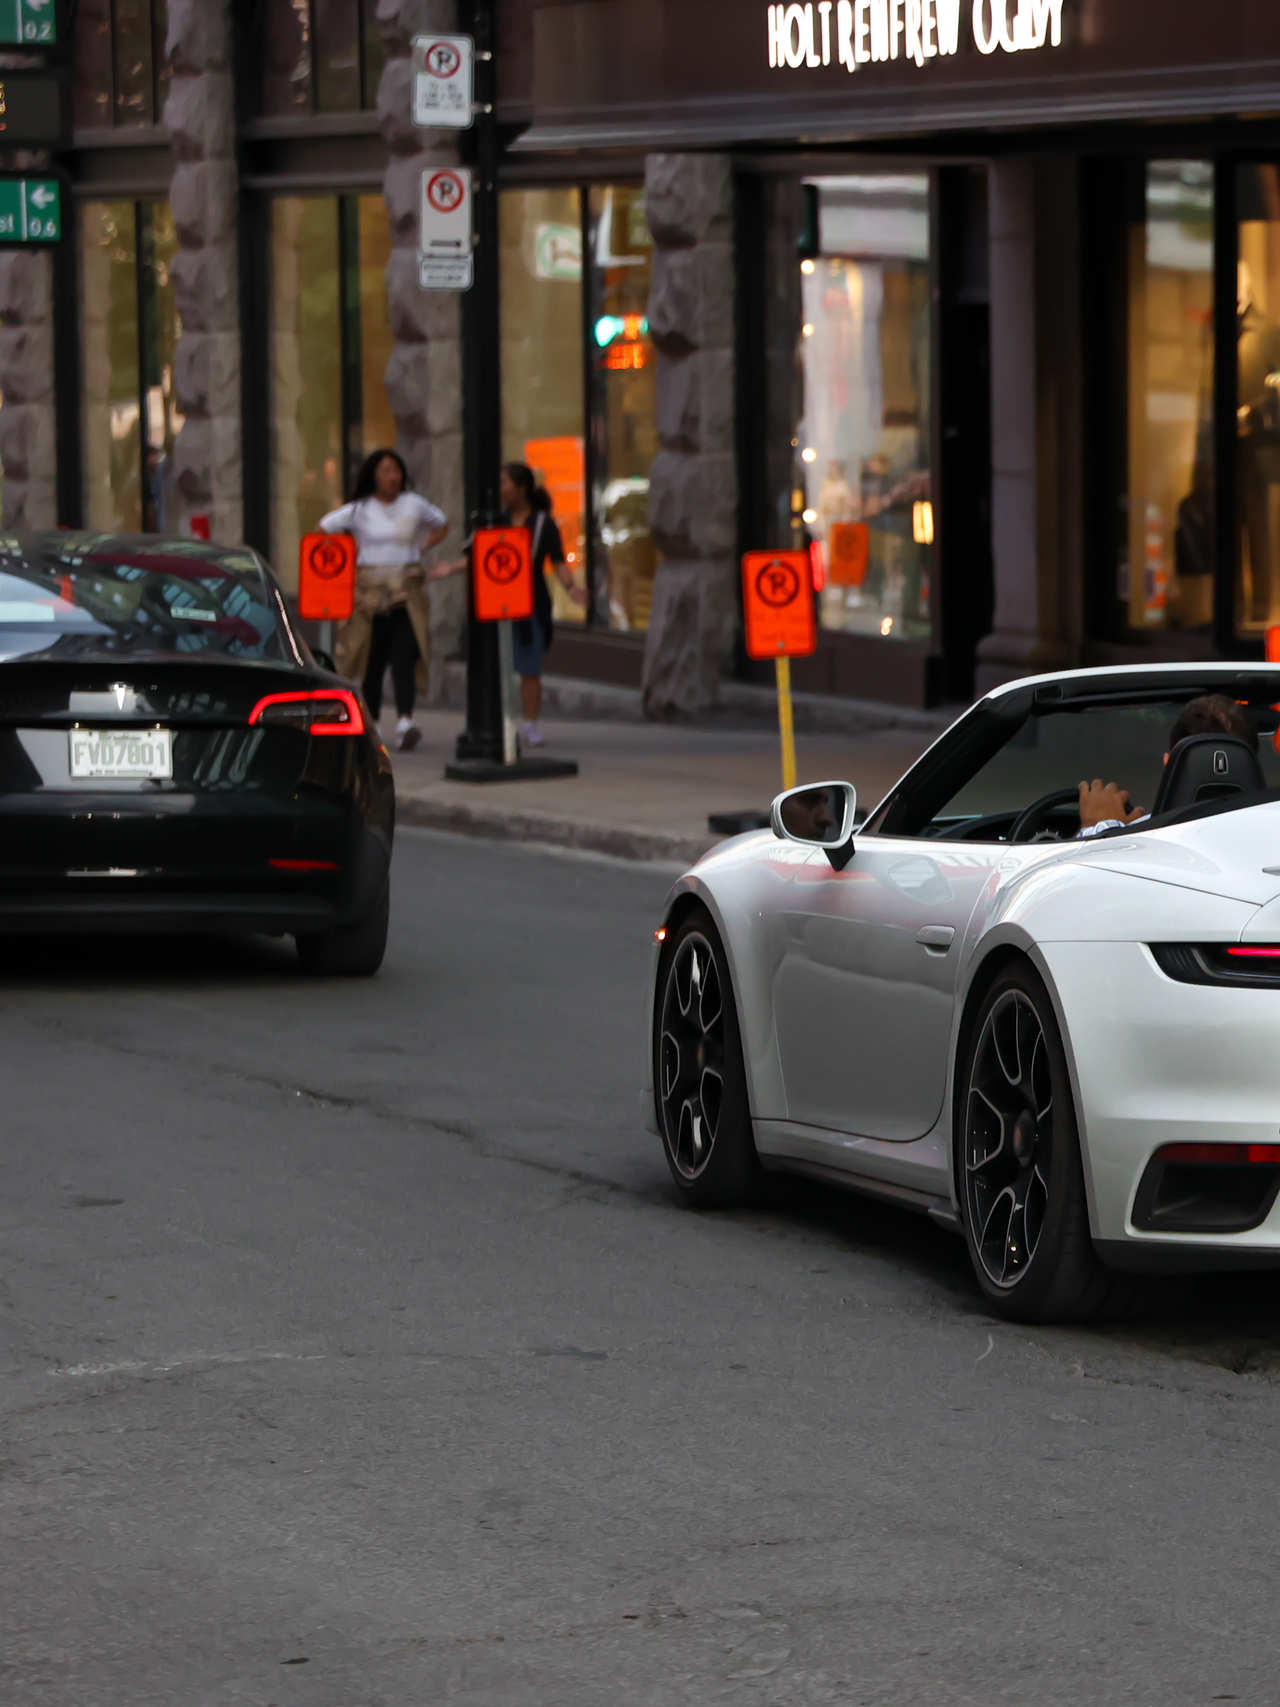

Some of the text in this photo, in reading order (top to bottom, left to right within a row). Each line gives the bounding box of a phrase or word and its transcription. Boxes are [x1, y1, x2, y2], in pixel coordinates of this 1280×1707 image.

[767, 2, 832, 68] HOLT
[837, 0, 961, 73] RENFREW
[74, 742, 166, 767] FVD7801
